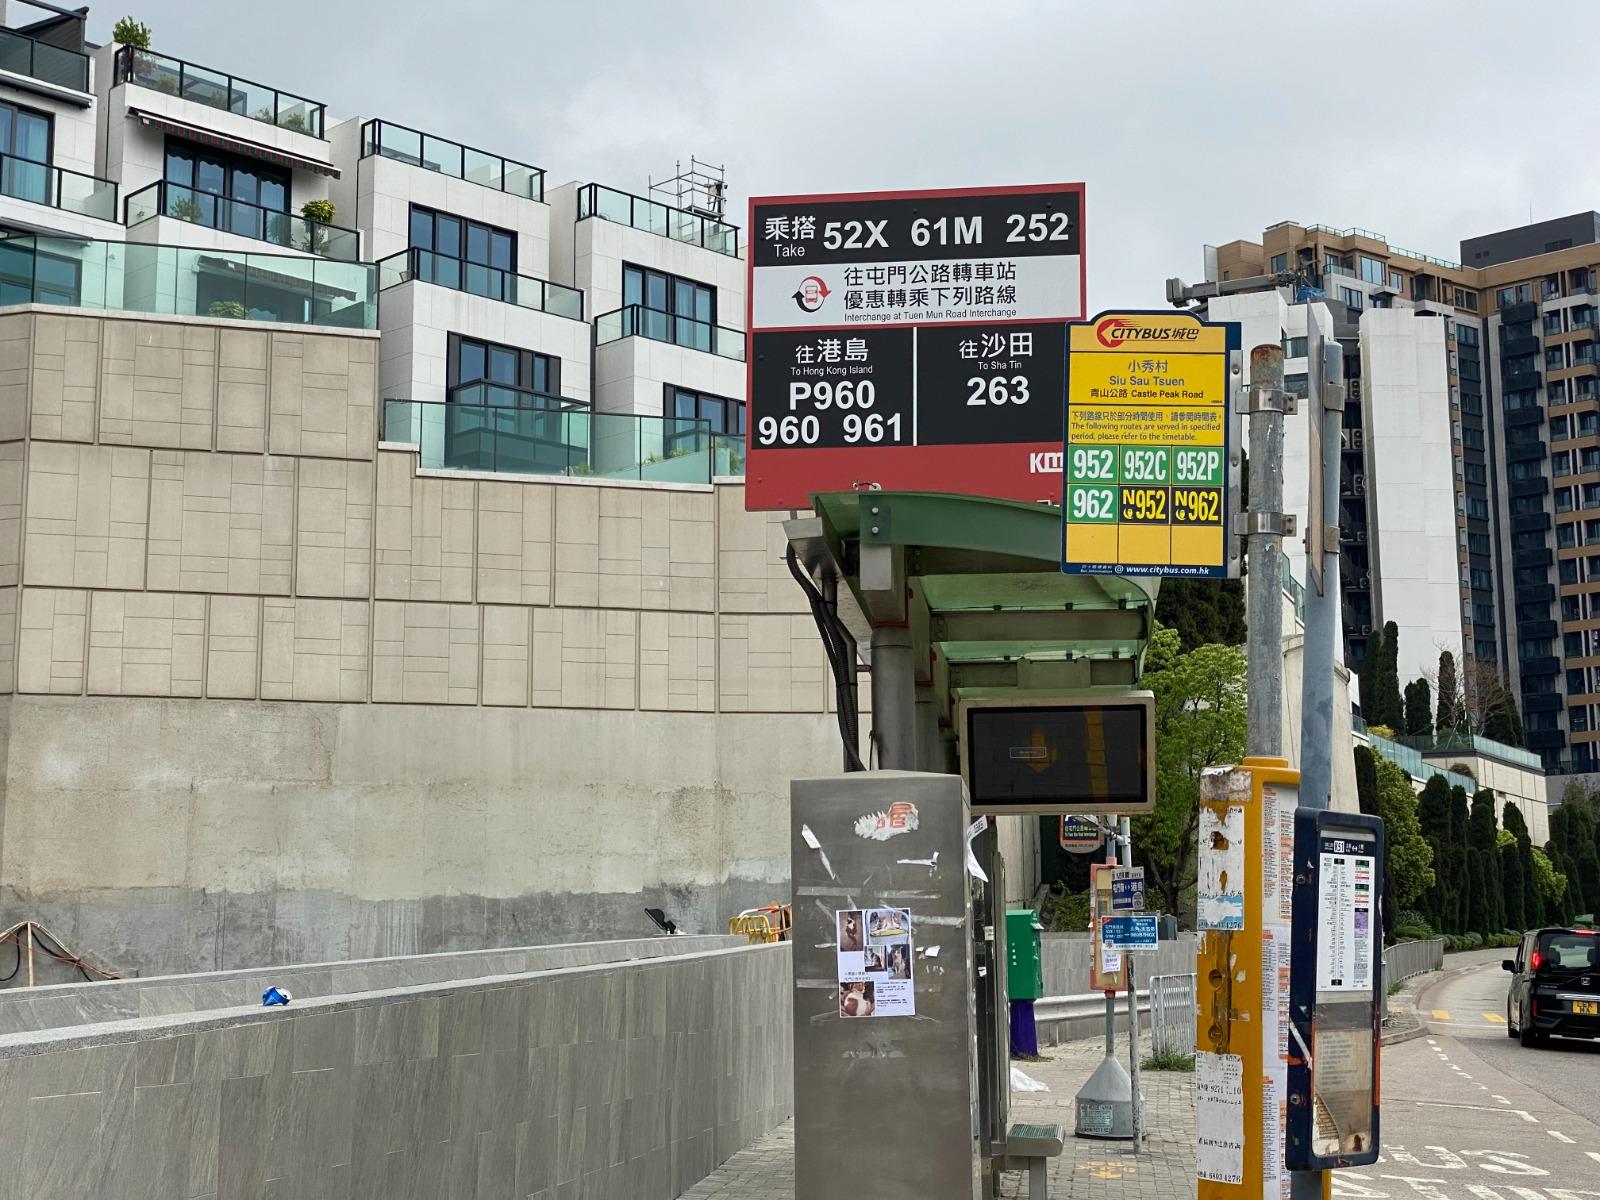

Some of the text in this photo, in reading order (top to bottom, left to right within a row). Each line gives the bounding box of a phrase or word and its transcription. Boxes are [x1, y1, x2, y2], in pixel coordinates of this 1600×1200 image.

[765, 216, 816, 241] 乘搭
[823, 212, 1069, 250] 52X 61M 252
[773, 245, 806, 258] Take
[844, 262, 1016, 287] 往屯門公路轉車站
[844, 286, 1016, 310] 優惠轉乘下列路線
[844, 308, 1017, 323] Interchange at Tuen Mun Road Interchange
[1111, 327, 1199, 340] CITYBUS 城巴
[795, 338, 869, 364] 往港島
[959, 332, 1033, 359] 往沙田
[791, 365, 873, 377] To Hong Kong Island
[978, 360, 1022, 370] To Sha Tin
[1128, 359, 1168, 373] 小秀村
[966, 375, 1031, 406] 263
[1109, 376, 1185, 386] Siu Sau Tsuen
[789, 380, 876, 411] P960
[1090, 388, 1128, 398] 青山公路
[1131, 390, 1204, 399] Castle Peak Road
[758, 413, 901, 445] 960 961
[1071, 422, 1084, 430] The
[1086, 422, 1118, 432] following
[1156, 423, 1180, 431] served
[1190, 423, 1220, 432] specified
[1071, 433, 1094, 441] period,
[1097, 433, 1119, 441] please
[1162, 433, 1198, 441] timetable.
[1030, 452, 1063, 473] KM
[1073, 449, 1219, 481] 952 952C 952P
[1073, 489, 1219, 521] 962 N952 N962
[1126, 565, 1209, 575] www.citybus.com.hk
[1378, 1144, 1551, 1176] US
